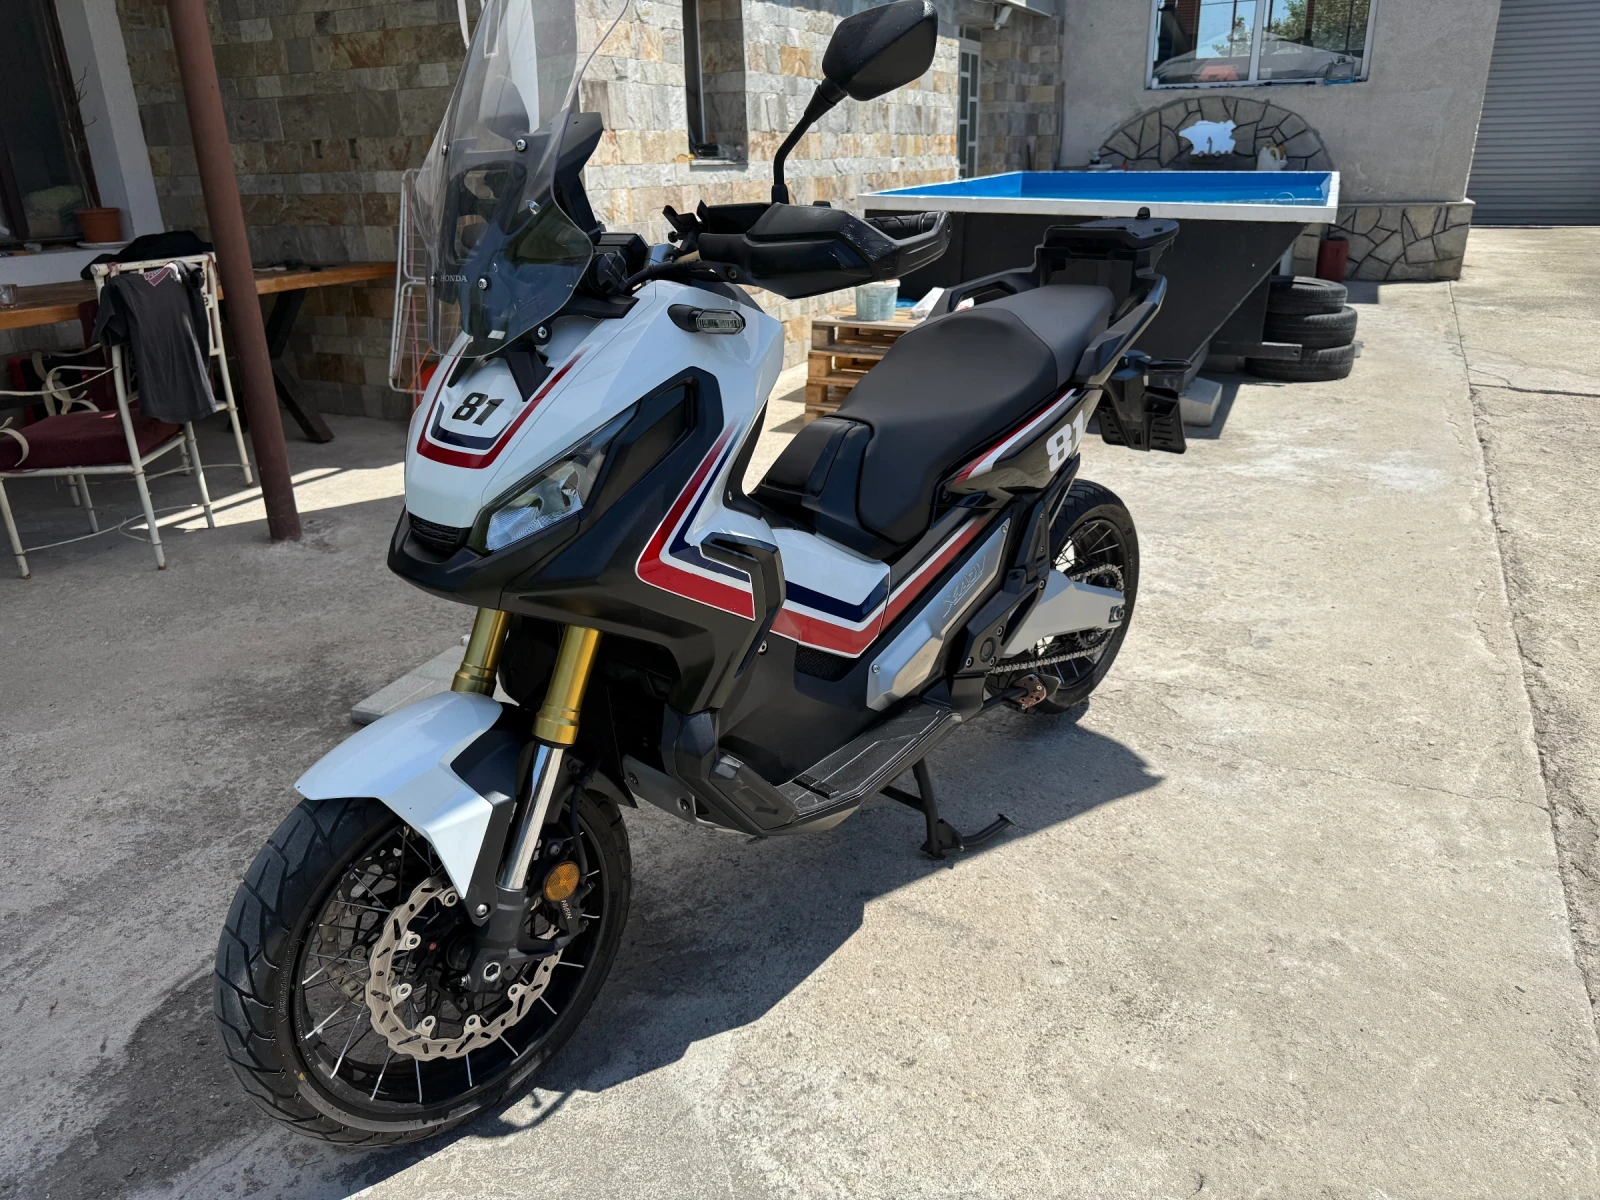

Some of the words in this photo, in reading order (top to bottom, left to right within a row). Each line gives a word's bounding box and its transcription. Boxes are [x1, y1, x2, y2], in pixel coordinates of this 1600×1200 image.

[440, 274, 468, 283] HONDA
[451, 392, 505, 426] 81
[1046, 409, 1084, 472] 81
